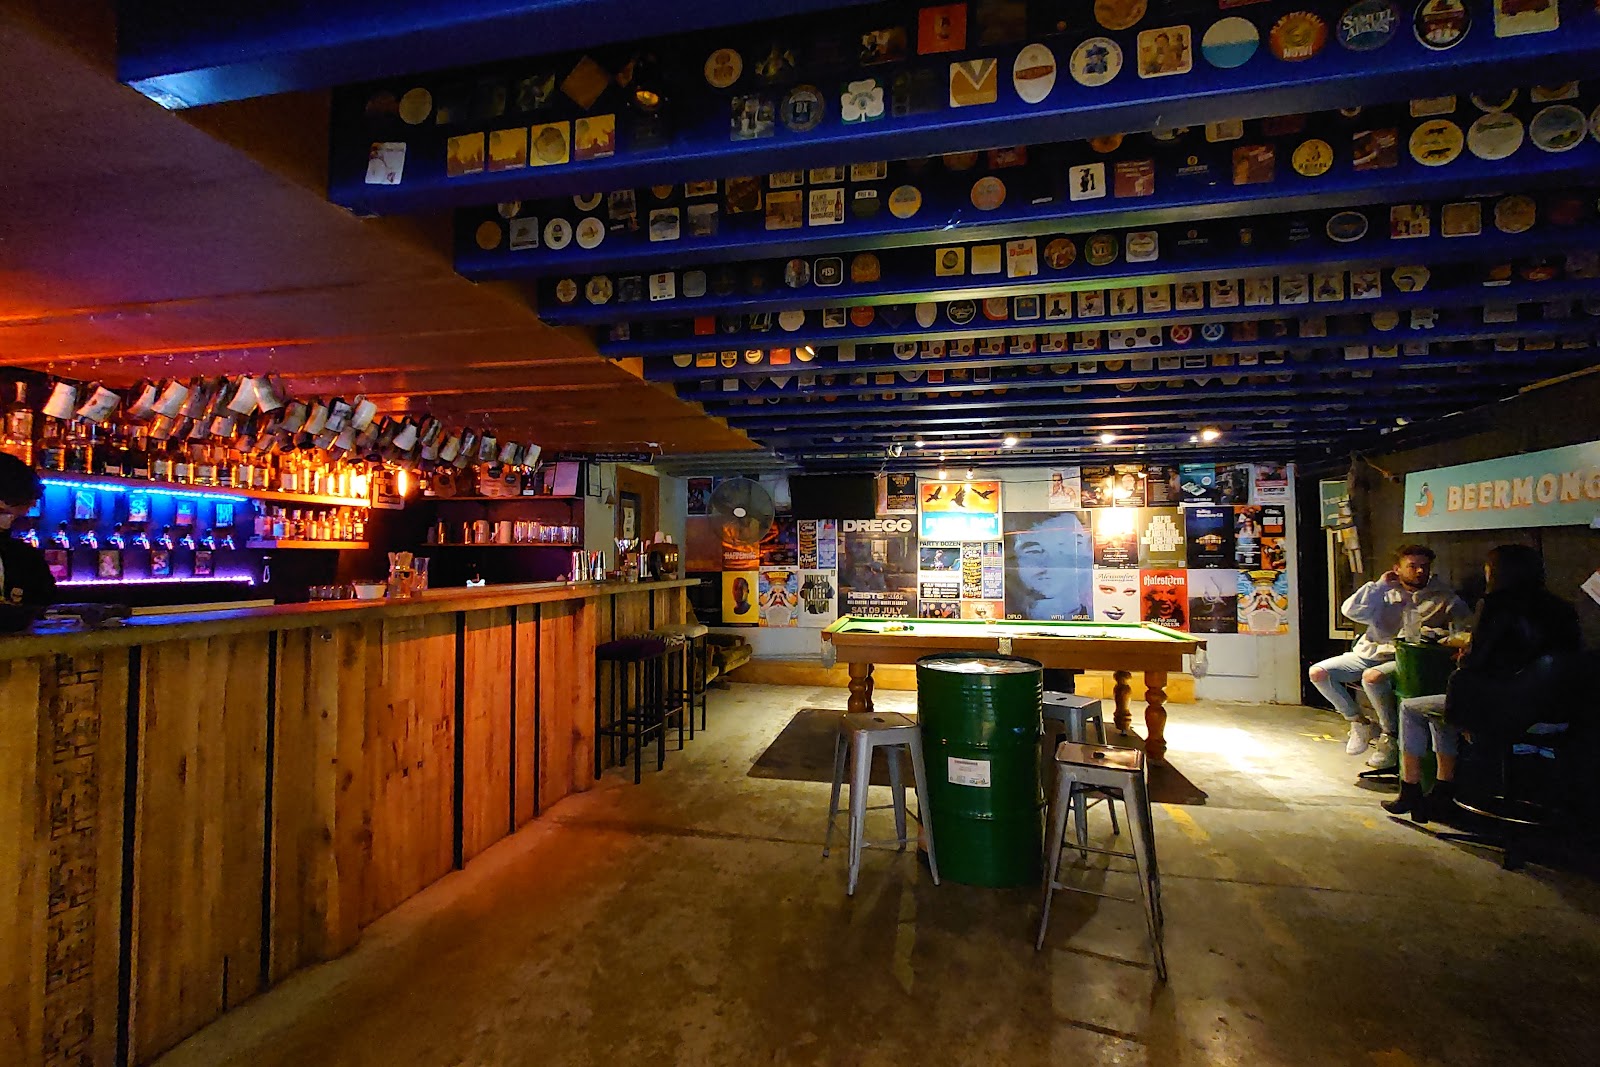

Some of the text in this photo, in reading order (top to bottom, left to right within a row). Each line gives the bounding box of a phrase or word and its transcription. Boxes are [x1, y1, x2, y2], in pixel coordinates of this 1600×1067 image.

[1343, 9, 1395, 30] SAMUEL
[843, 519, 912, 532] DREGG
[851, 606, 903, 614] SAT 09 JULY
